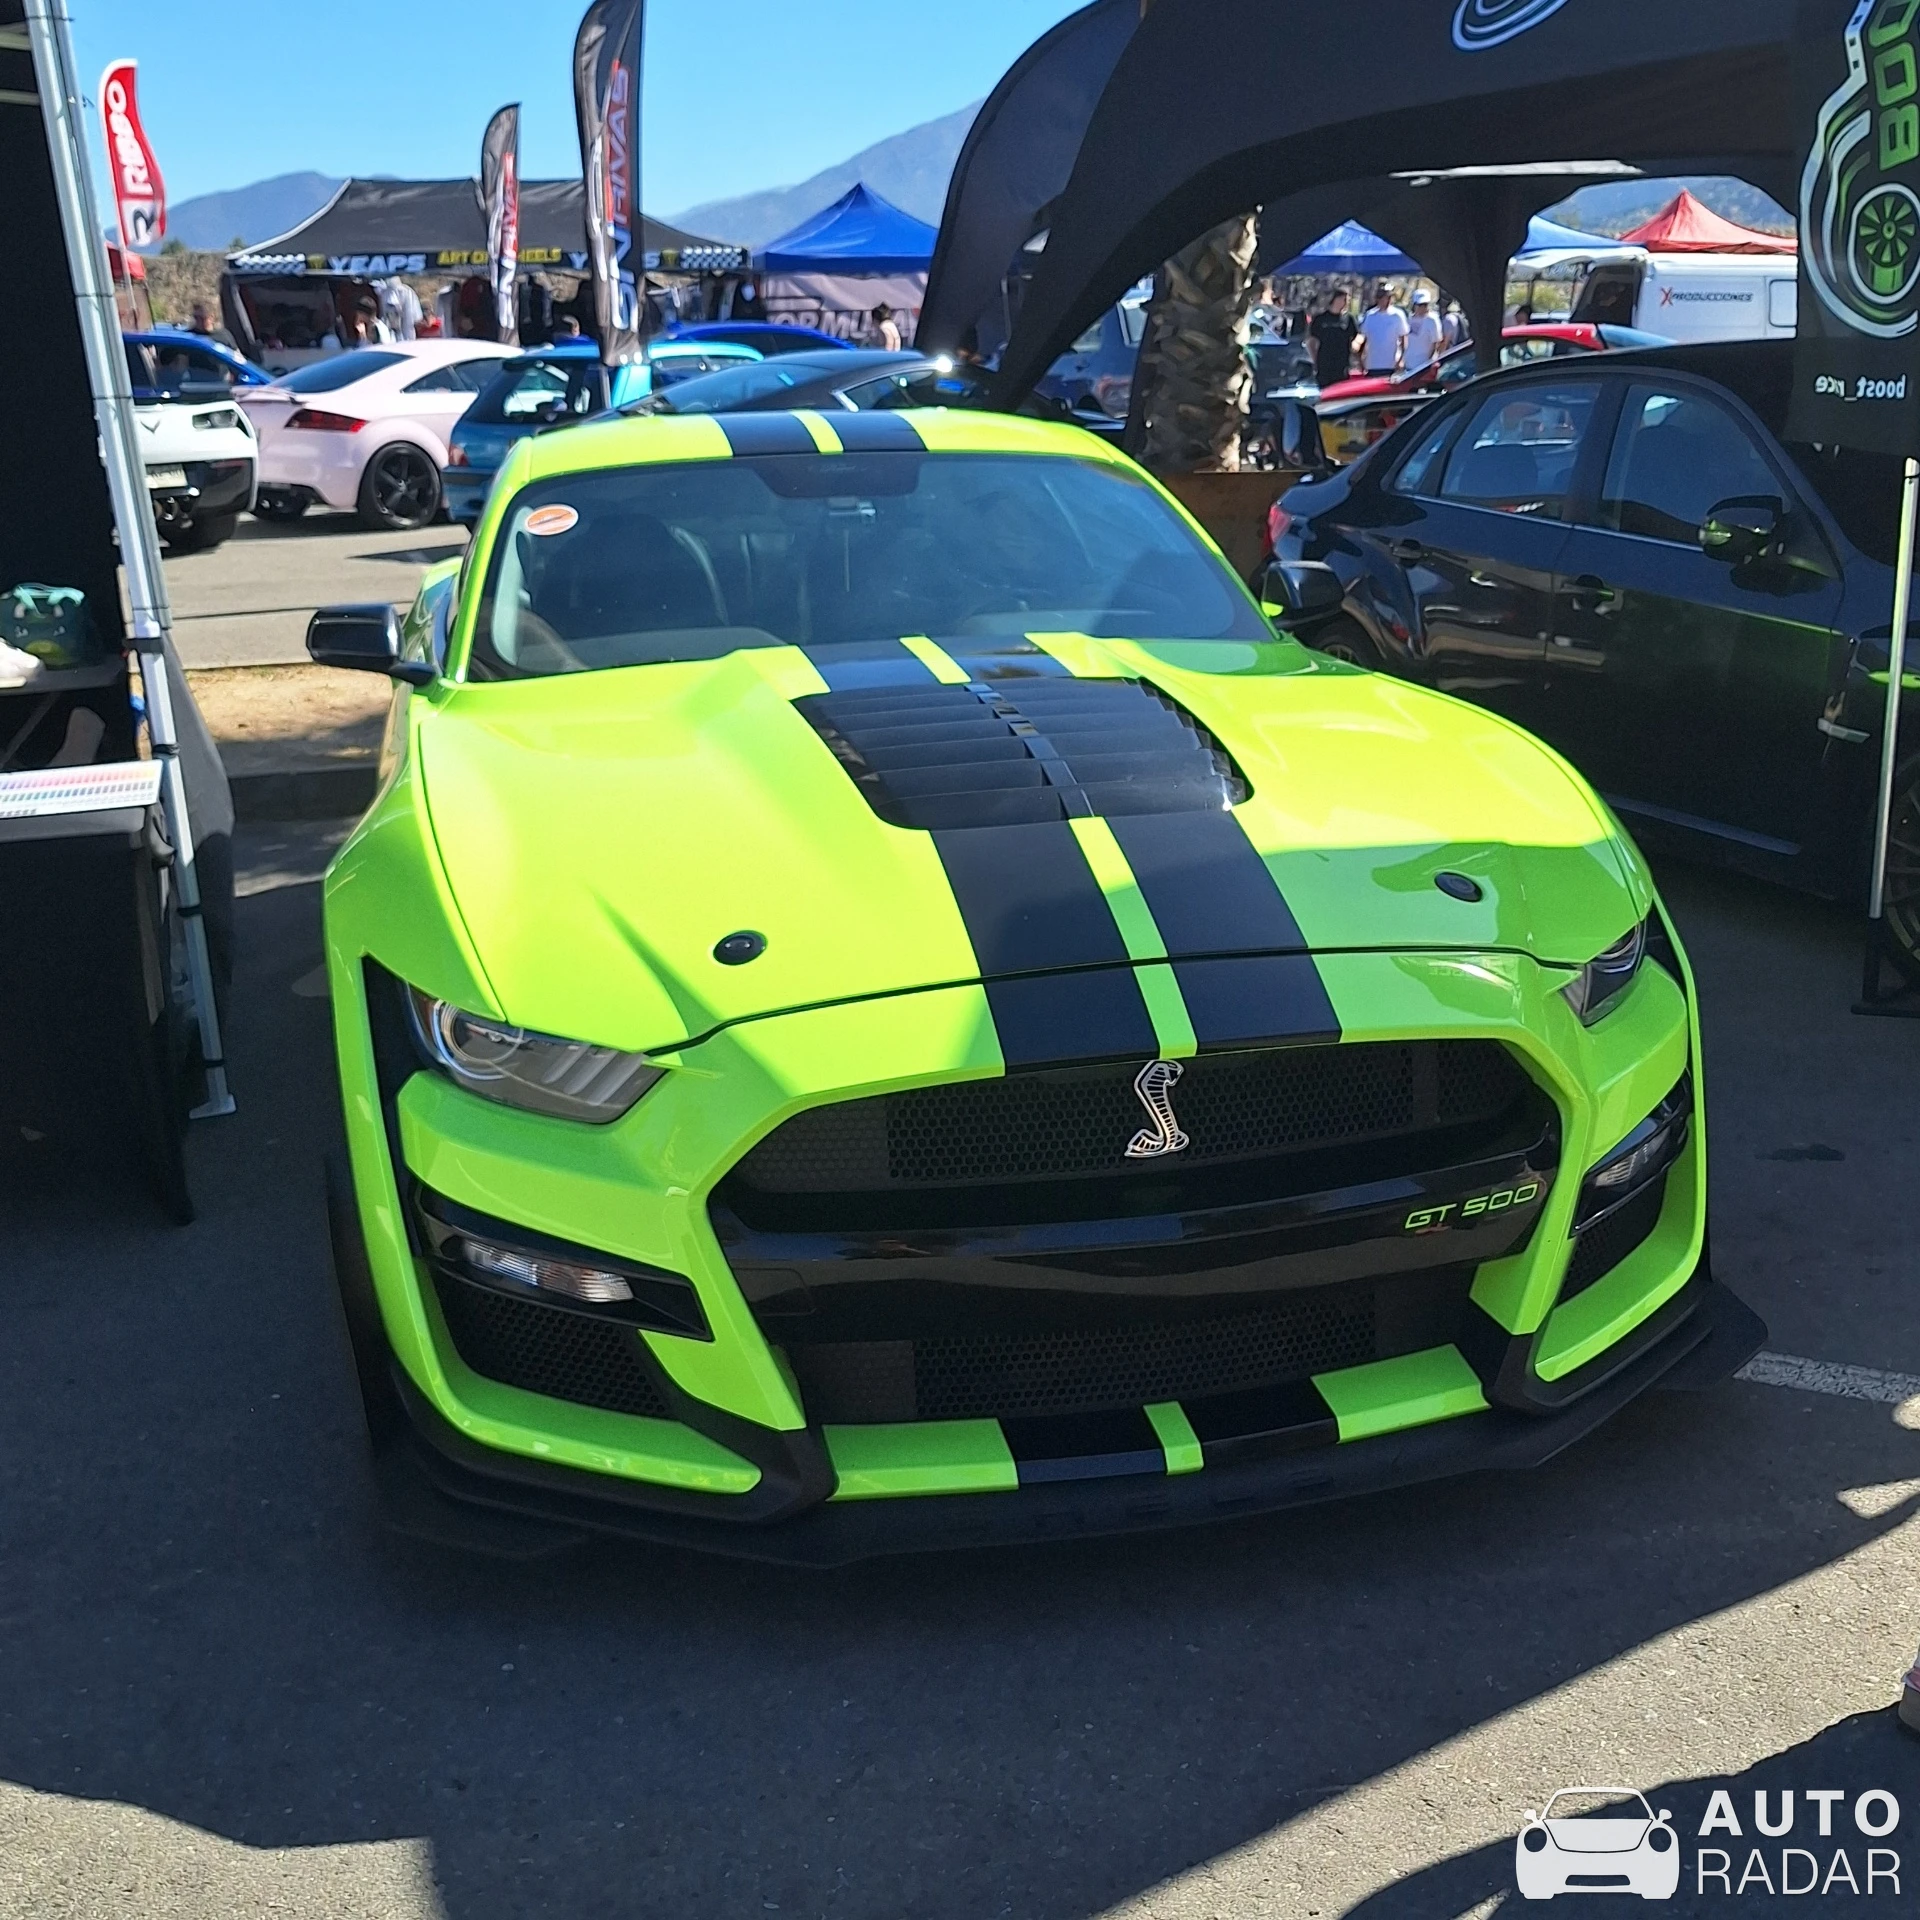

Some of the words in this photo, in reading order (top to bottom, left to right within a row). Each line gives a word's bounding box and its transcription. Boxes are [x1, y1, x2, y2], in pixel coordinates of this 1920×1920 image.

[438, 250, 470, 265] ART
[1405, 1203, 1457, 1229] GT
[1461, 1183, 1539, 1217] 500
